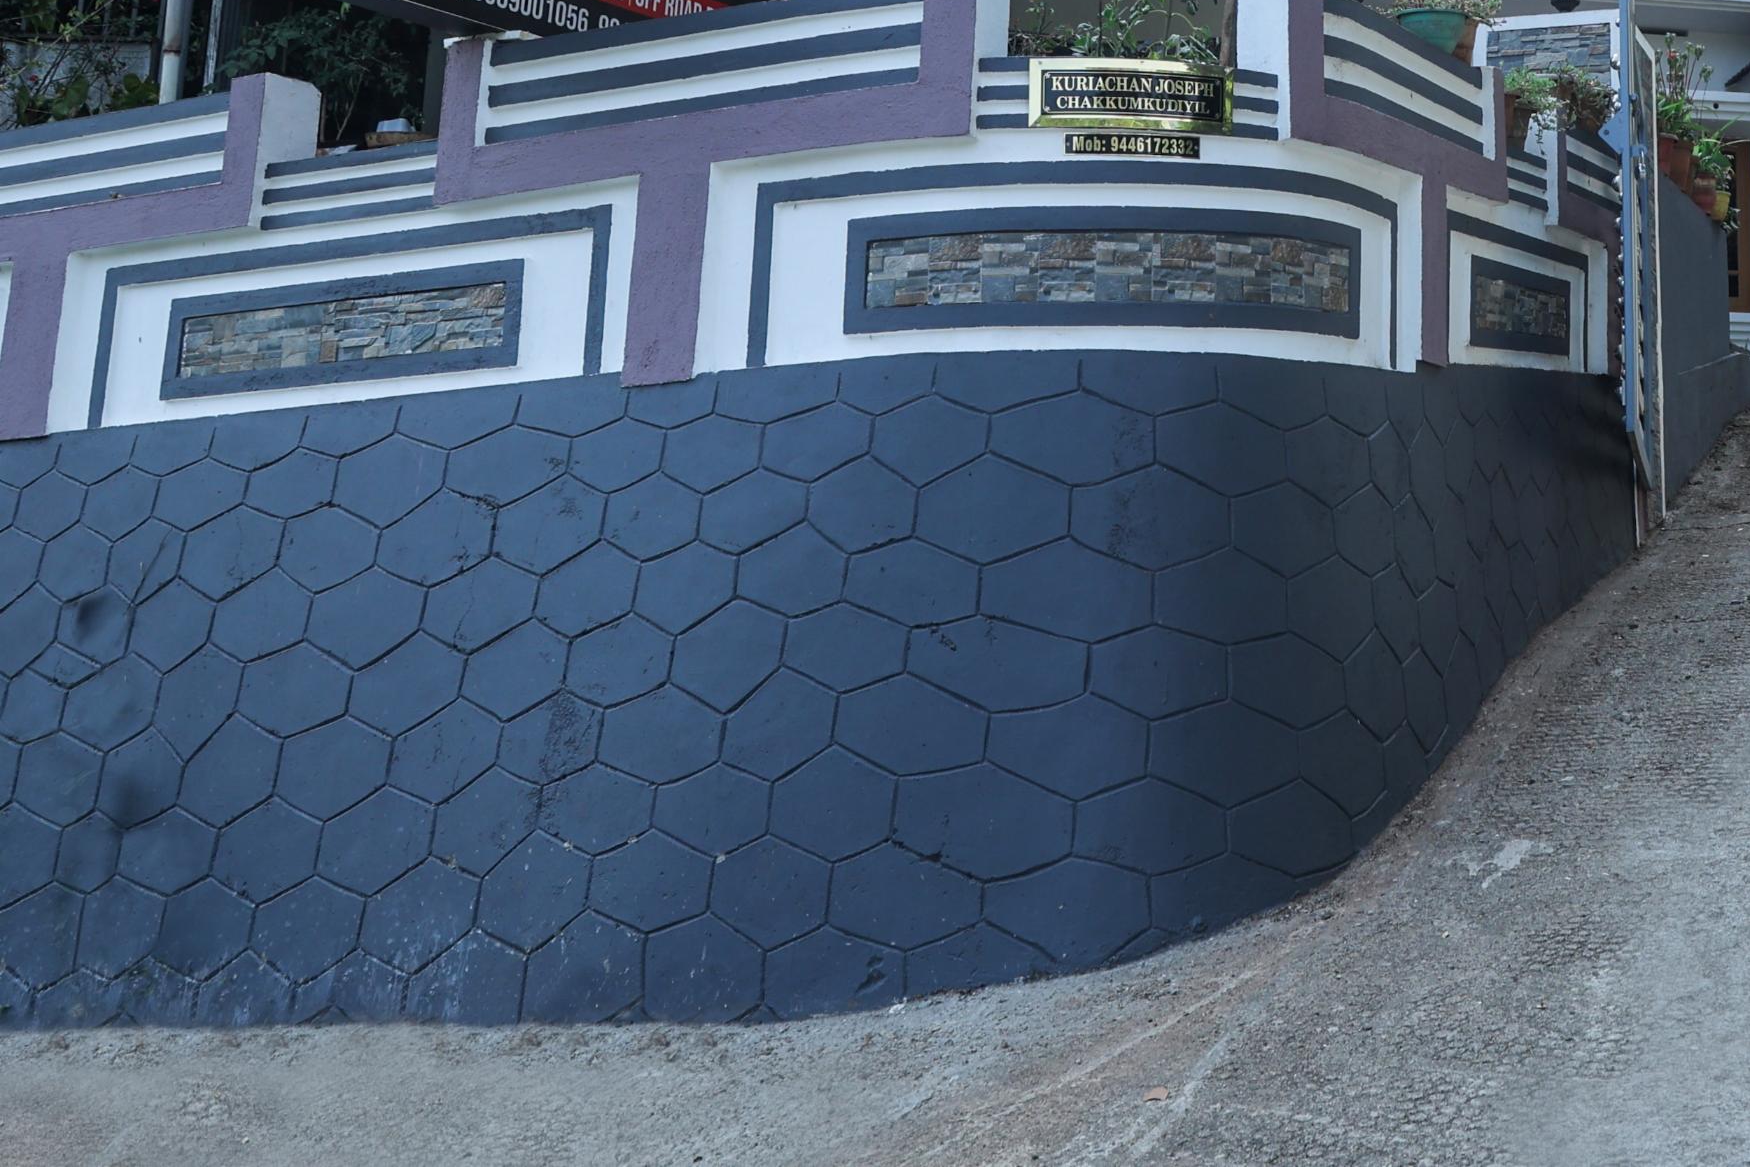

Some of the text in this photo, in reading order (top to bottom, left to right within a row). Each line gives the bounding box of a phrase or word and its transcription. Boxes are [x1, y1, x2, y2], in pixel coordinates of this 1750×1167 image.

[1050, 75, 1215, 98] KURIACHAN JOSEPH
[1055, 96, 1211, 115] CHAKKUMKUDIYIL
[1072, 136, 1194, 155] Mob: 9446172332
